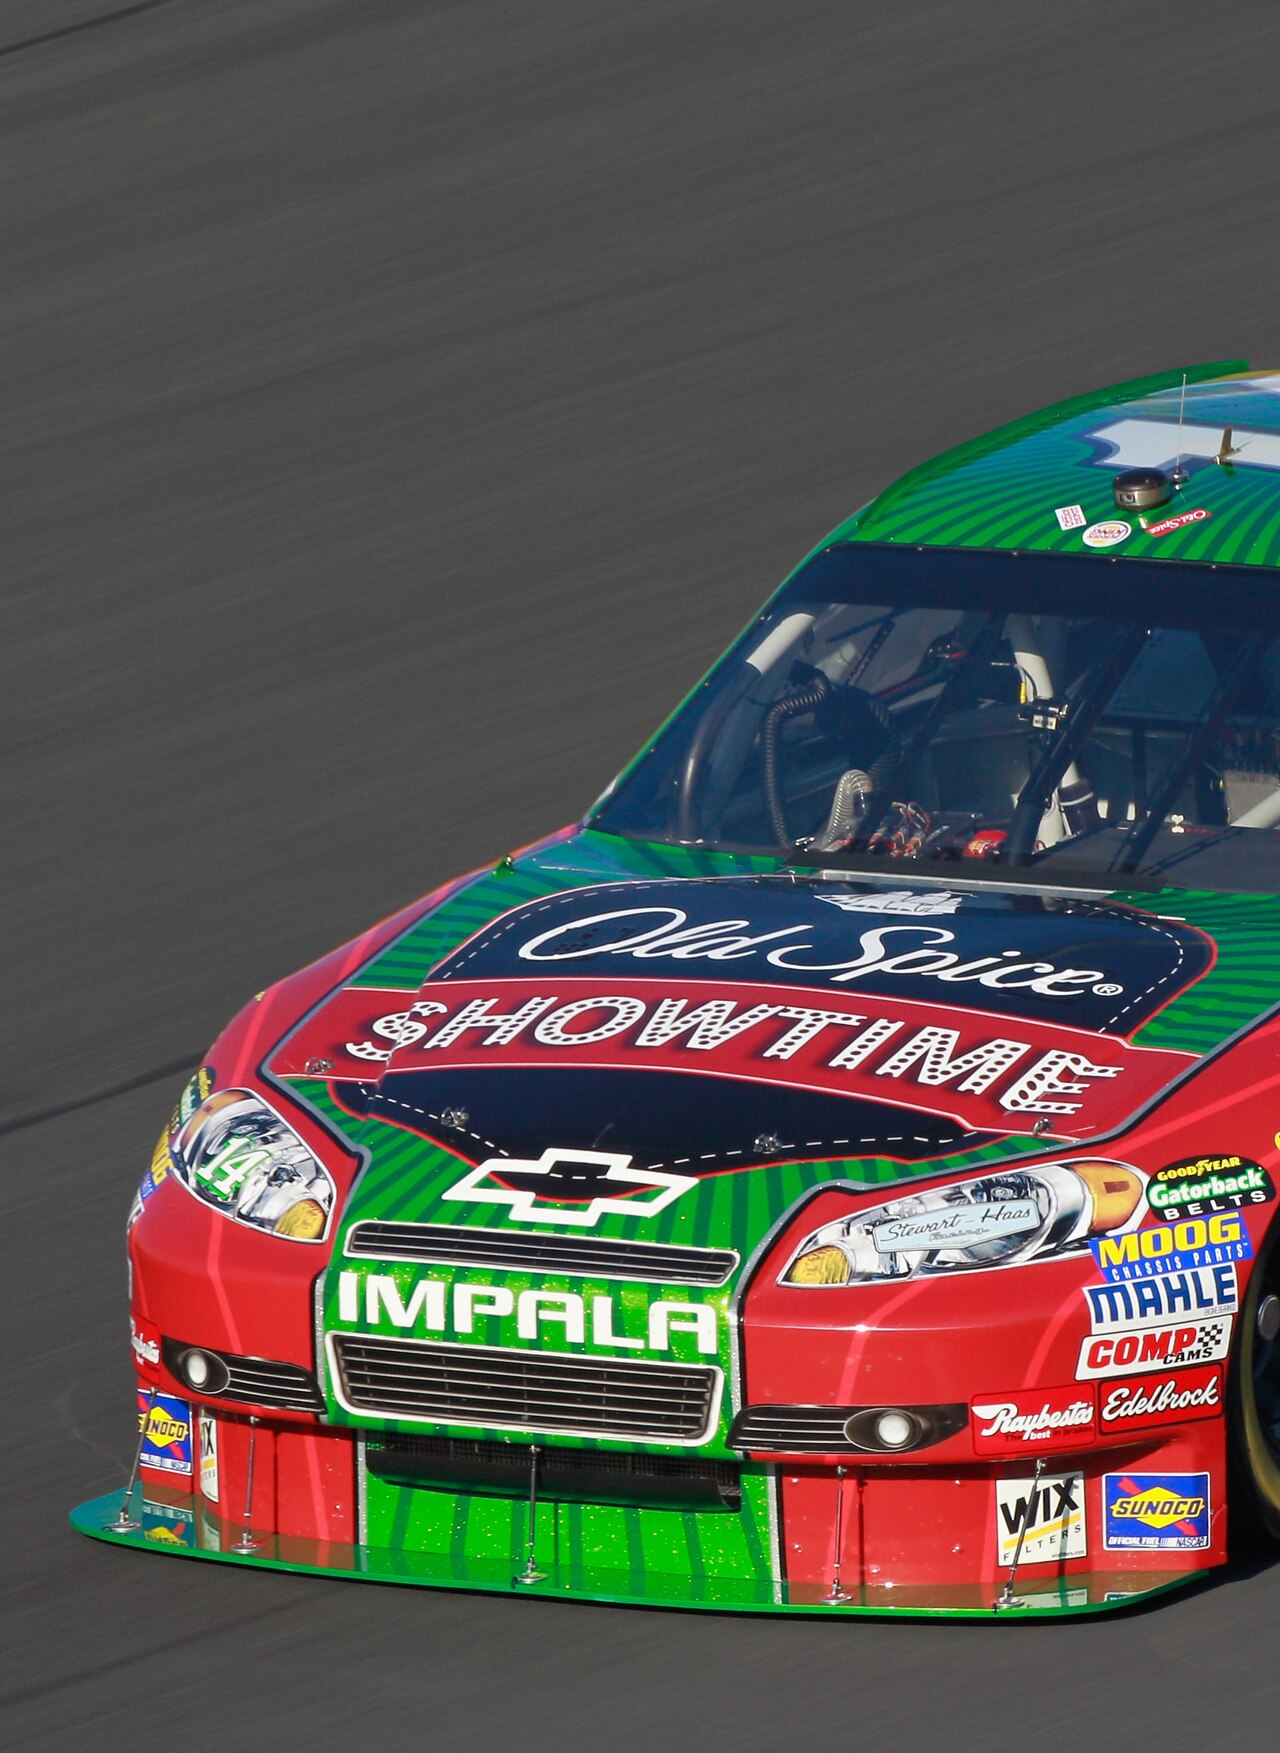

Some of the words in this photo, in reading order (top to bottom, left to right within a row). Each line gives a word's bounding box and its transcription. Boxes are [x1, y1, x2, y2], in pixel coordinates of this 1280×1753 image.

[1178, 509, 1207, 524] Old
[518, 907, 813, 960] Old
[346, 996, 1124, 1115] SHOWTIME
[199, 1136, 271, 1198] 14
[1148, 1167, 1267, 1207] Gatorback
[1156, 1156, 1242, 1182] GOODYEAR
[886, 1213, 967, 1243] Stewart
[980, 1203, 1031, 1223] Haas
[1163, 1190, 1267, 1221] BELTS
[1098, 1211, 1241, 1268] MOOG
[1112, 1256, 1182, 1282] CHASSIS
[338, 1271, 718, 1355] IMPALA
[1088, 1264, 1236, 1324] MAHLE
[1087, 1327, 1198, 1369] COMP
[1162, 1346, 1214, 1365] CAMS
[1101, 1375, 1220, 1422] Edelbrock
[971, 1401, 1095, 1441] Raybestos
[1030, 1429, 1052, 1441] best
[1000, 1475, 1080, 1535] WIX
[1116, 1500, 1202, 1516] SUNOCO
[1003, 1524, 1082, 1562] FLTERS
